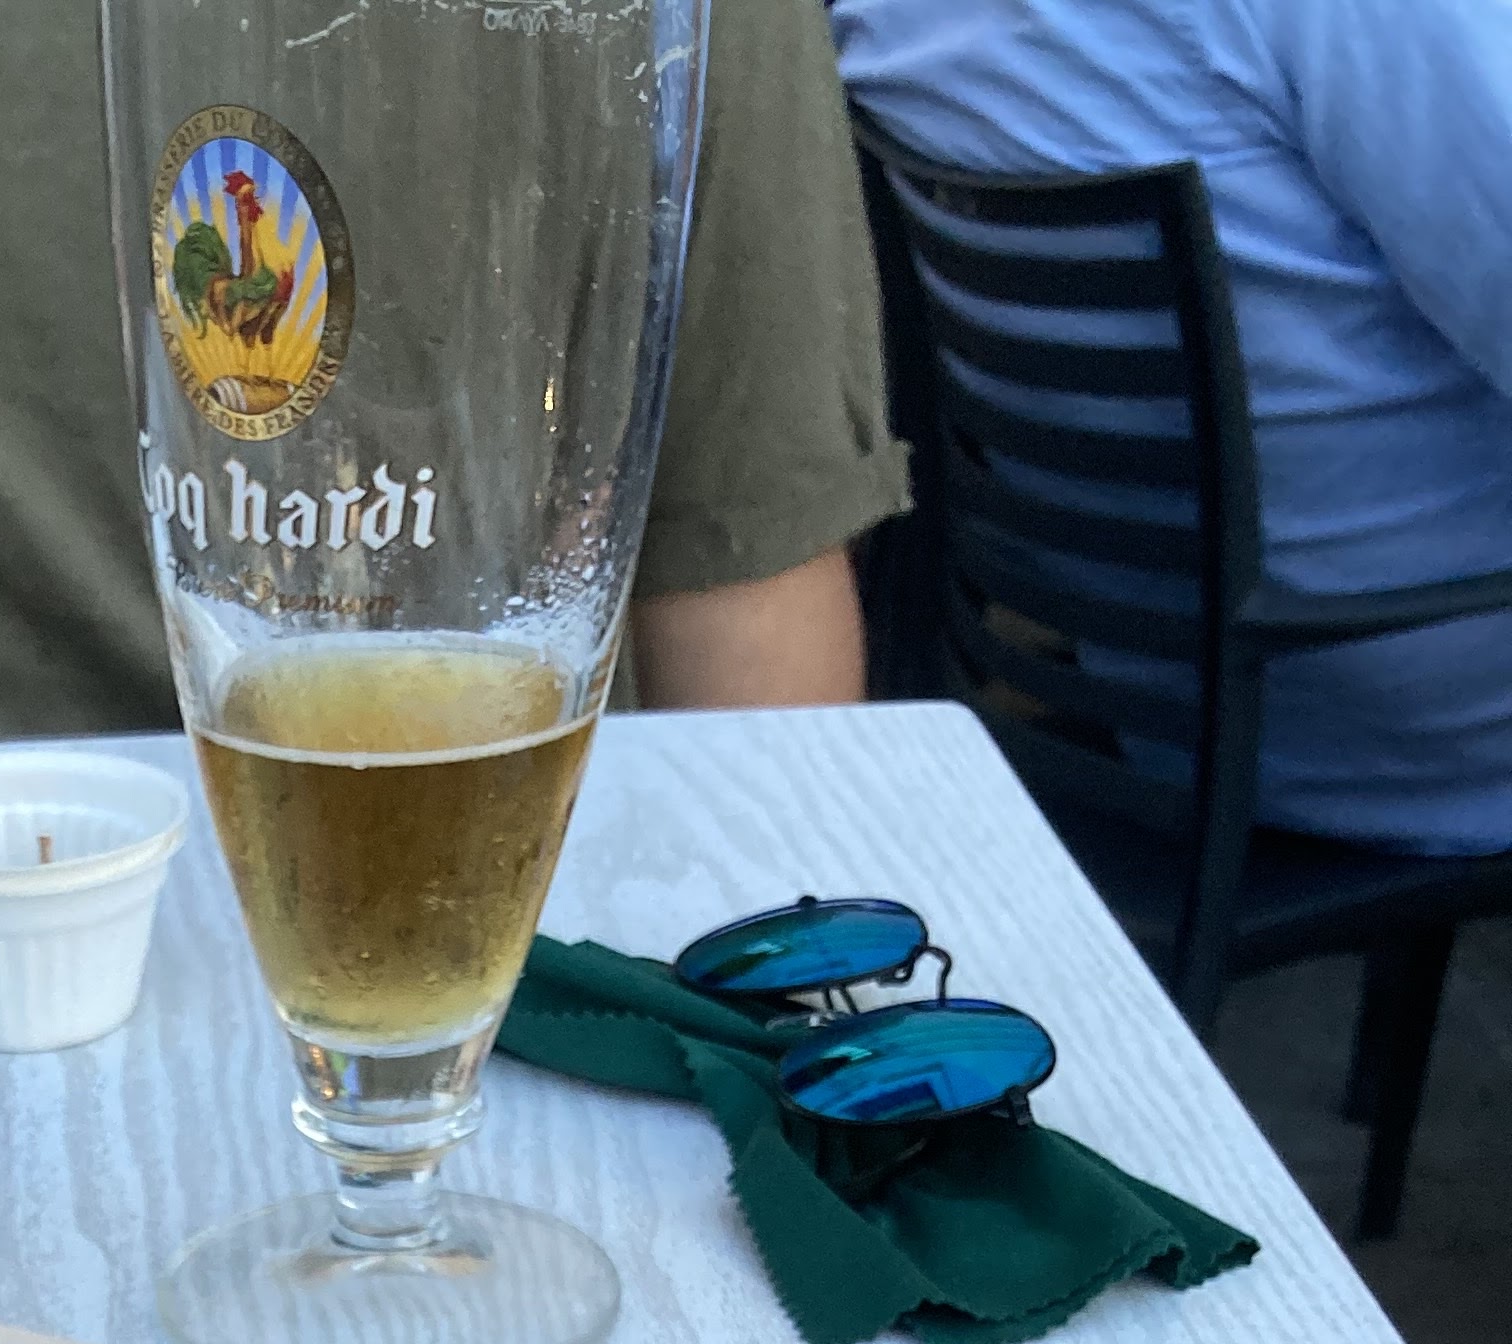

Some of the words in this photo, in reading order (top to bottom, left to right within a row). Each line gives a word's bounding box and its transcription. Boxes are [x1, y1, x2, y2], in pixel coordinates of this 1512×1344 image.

[212, 111, 245, 132] DU
[219, 411, 258, 437] DES
[224, 457, 438, 553] hardi
